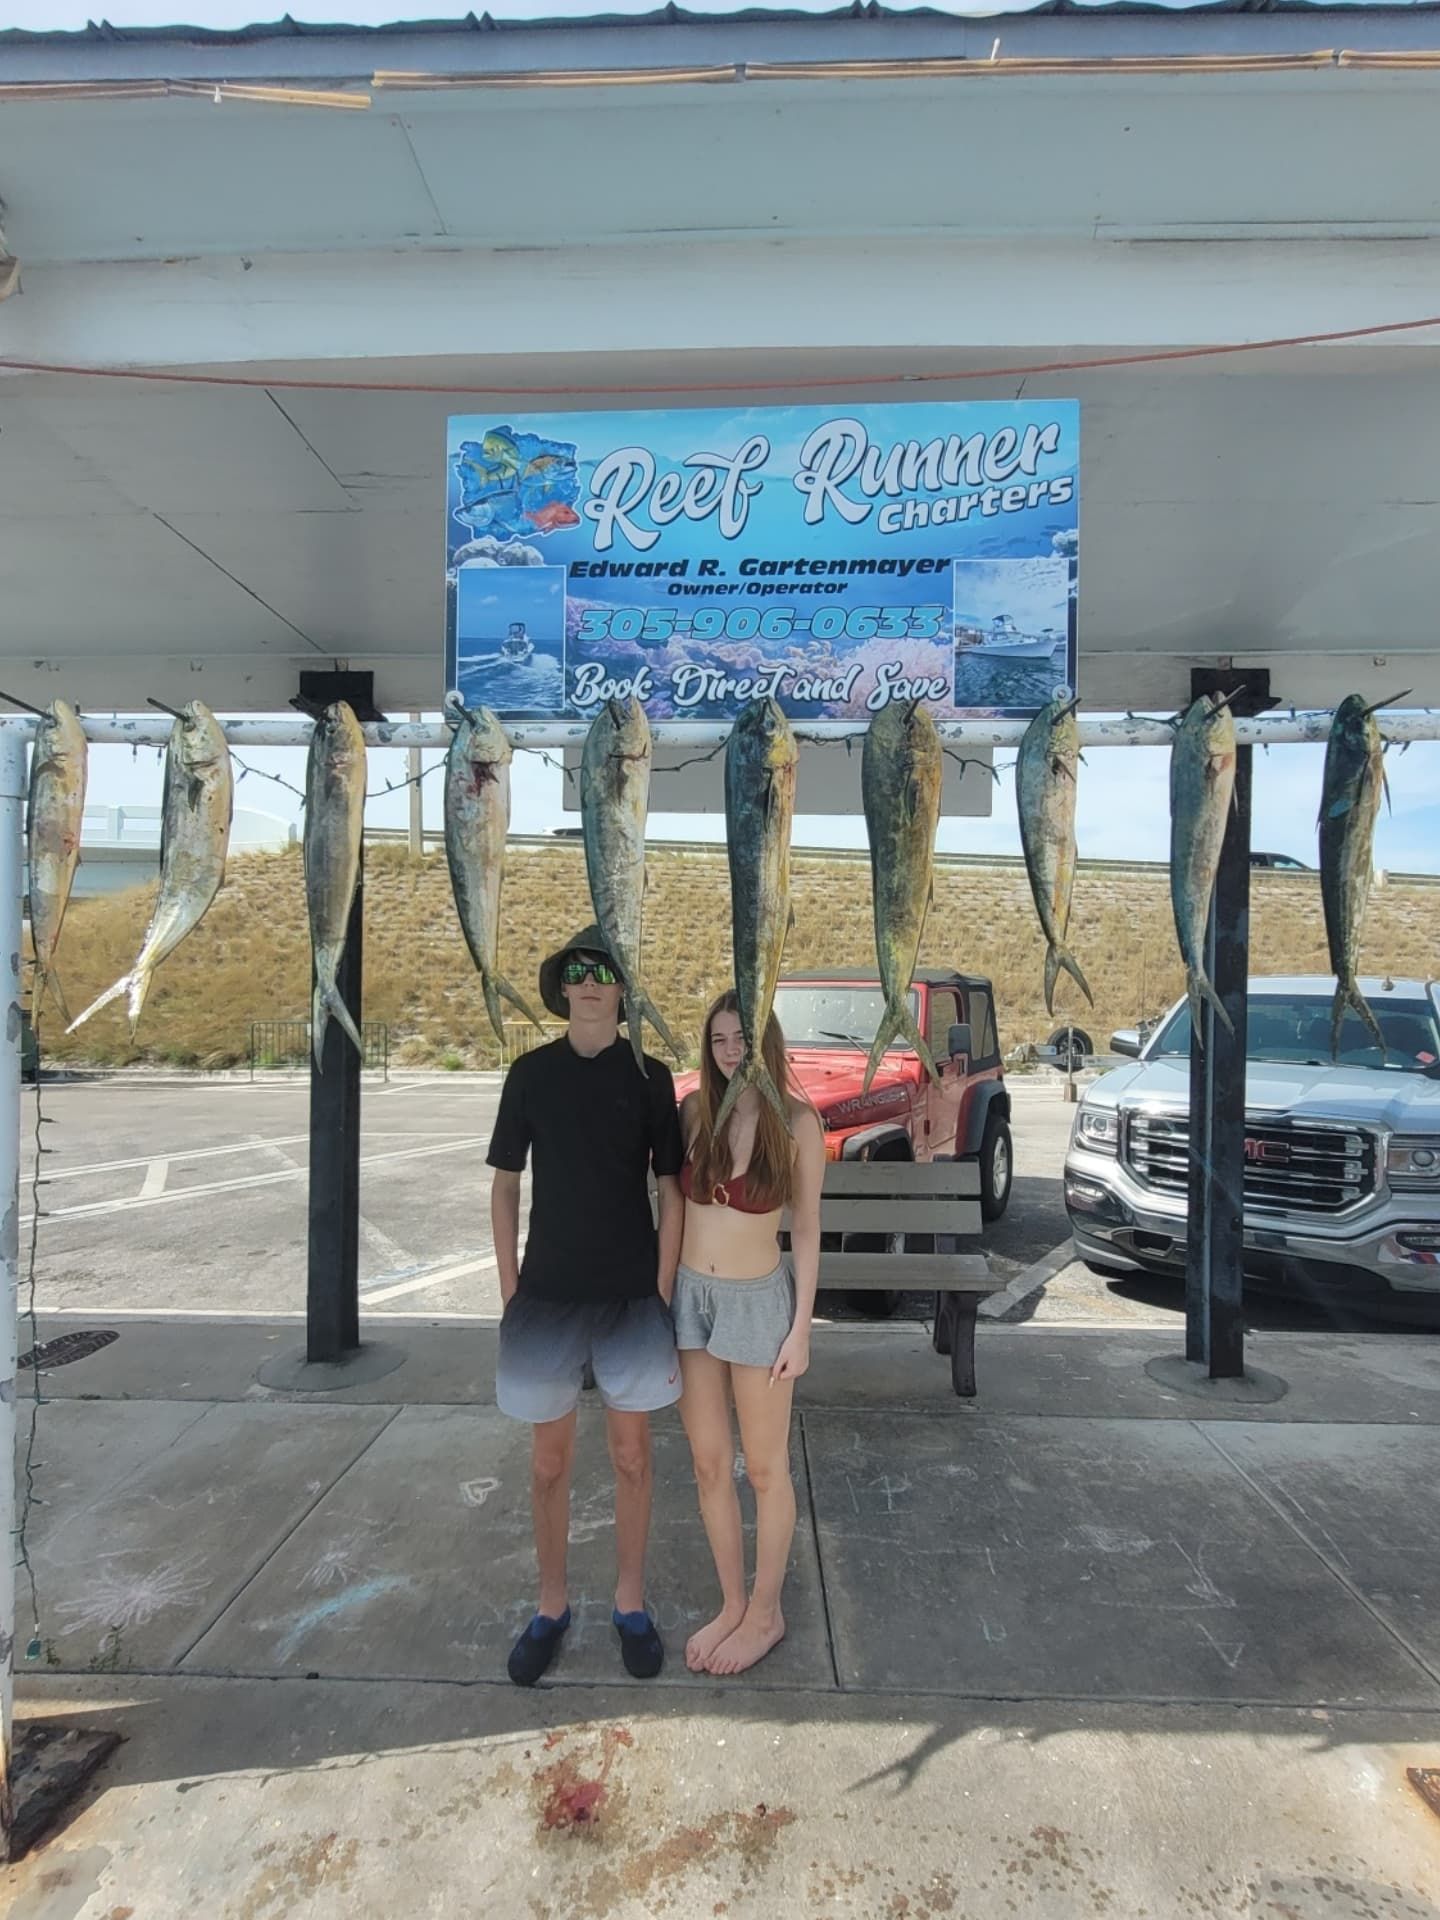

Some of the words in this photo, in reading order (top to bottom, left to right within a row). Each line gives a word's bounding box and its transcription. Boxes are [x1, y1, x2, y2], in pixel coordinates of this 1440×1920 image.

[583, 434, 771, 553] Reef
[792, 417, 1061, 525] Runner
[877, 475, 1074, 534] Charters
[569, 558, 690, 578] Edward
[698, 558, 726, 577] R.
[738, 556, 950, 577] Gartenmayer
[667, 581, 848, 597] Owner/Operator
[577, 605, 945, 641] 305-906-0633
[570, 661, 653, 707] Book
[671, 662, 797, 707] Direct
[791, 662, 864, 703] and
[865, 660, 950, 712] Save
